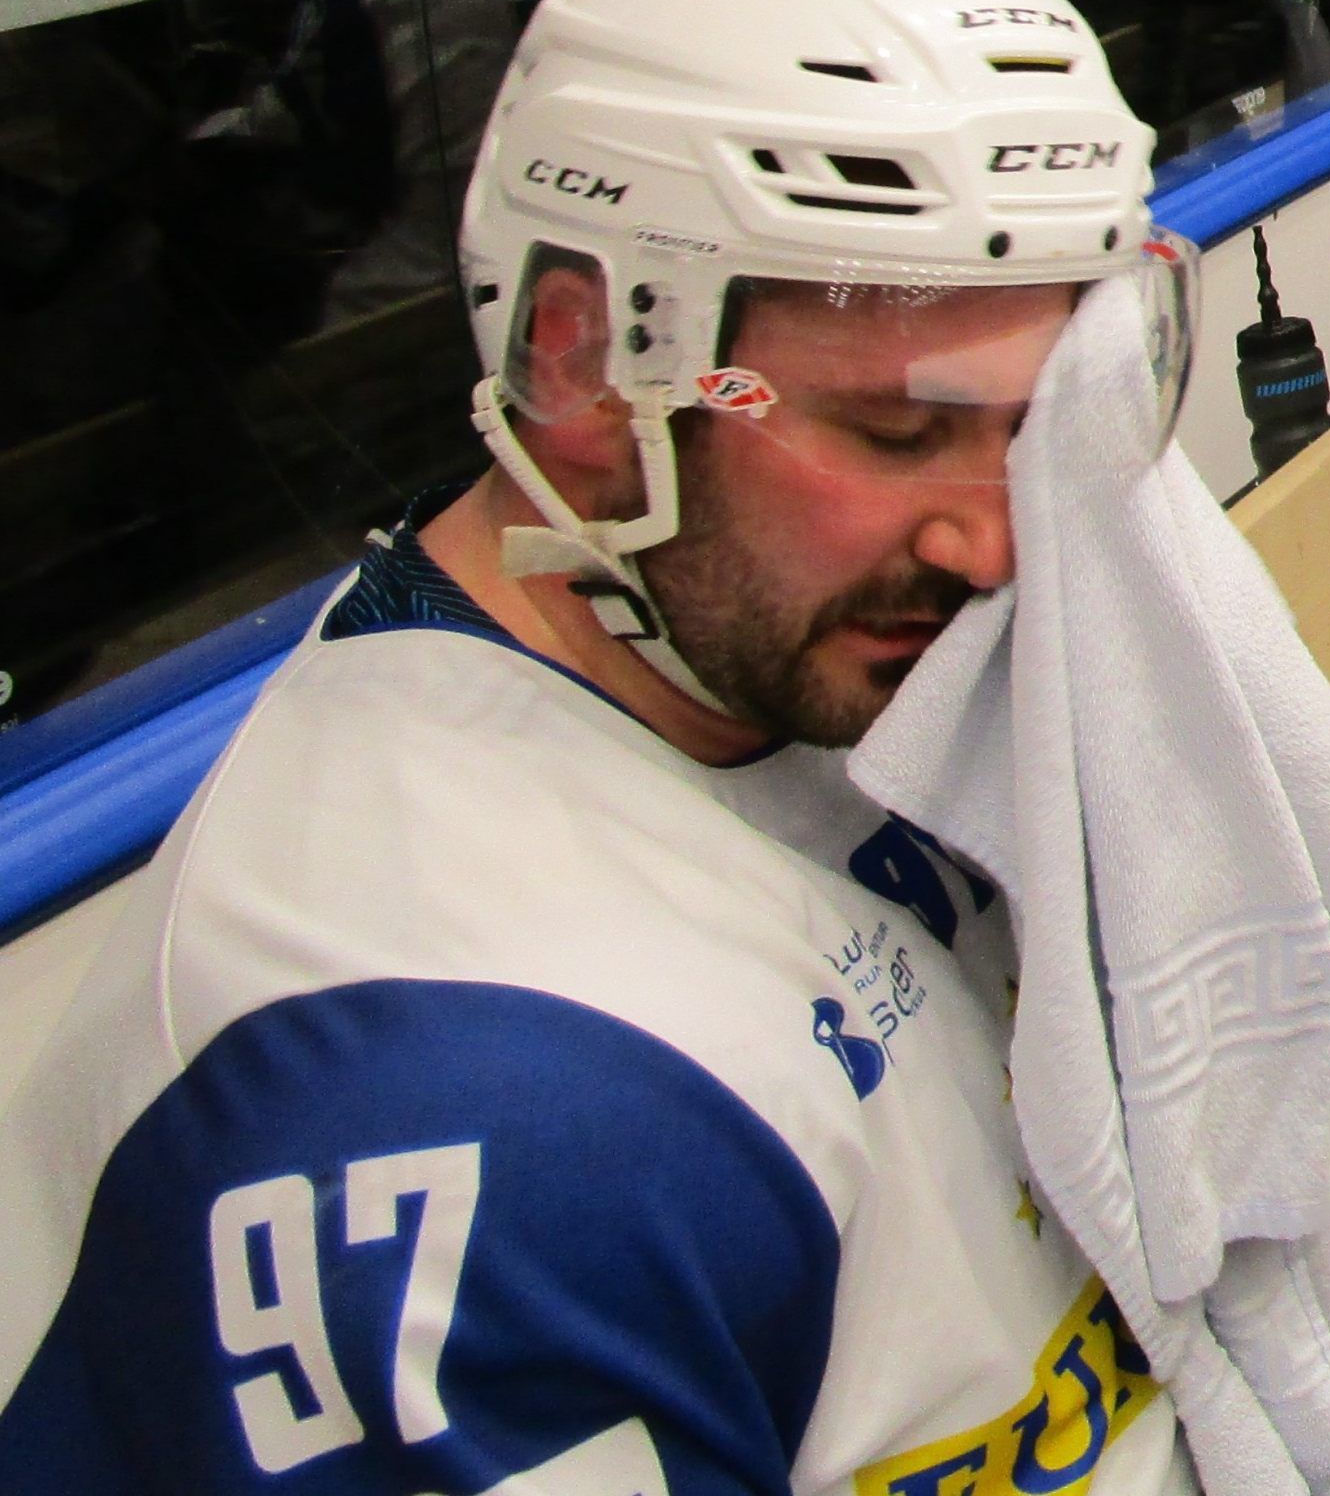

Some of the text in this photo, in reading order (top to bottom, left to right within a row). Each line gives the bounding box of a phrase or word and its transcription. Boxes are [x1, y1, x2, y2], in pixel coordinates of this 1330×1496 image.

[957, 6, 1077, 35] CCM
[986, 141, 1122, 173] CCM
[525, 157, 634, 205] CCM
[209, 1141, 482, 1474] 97
